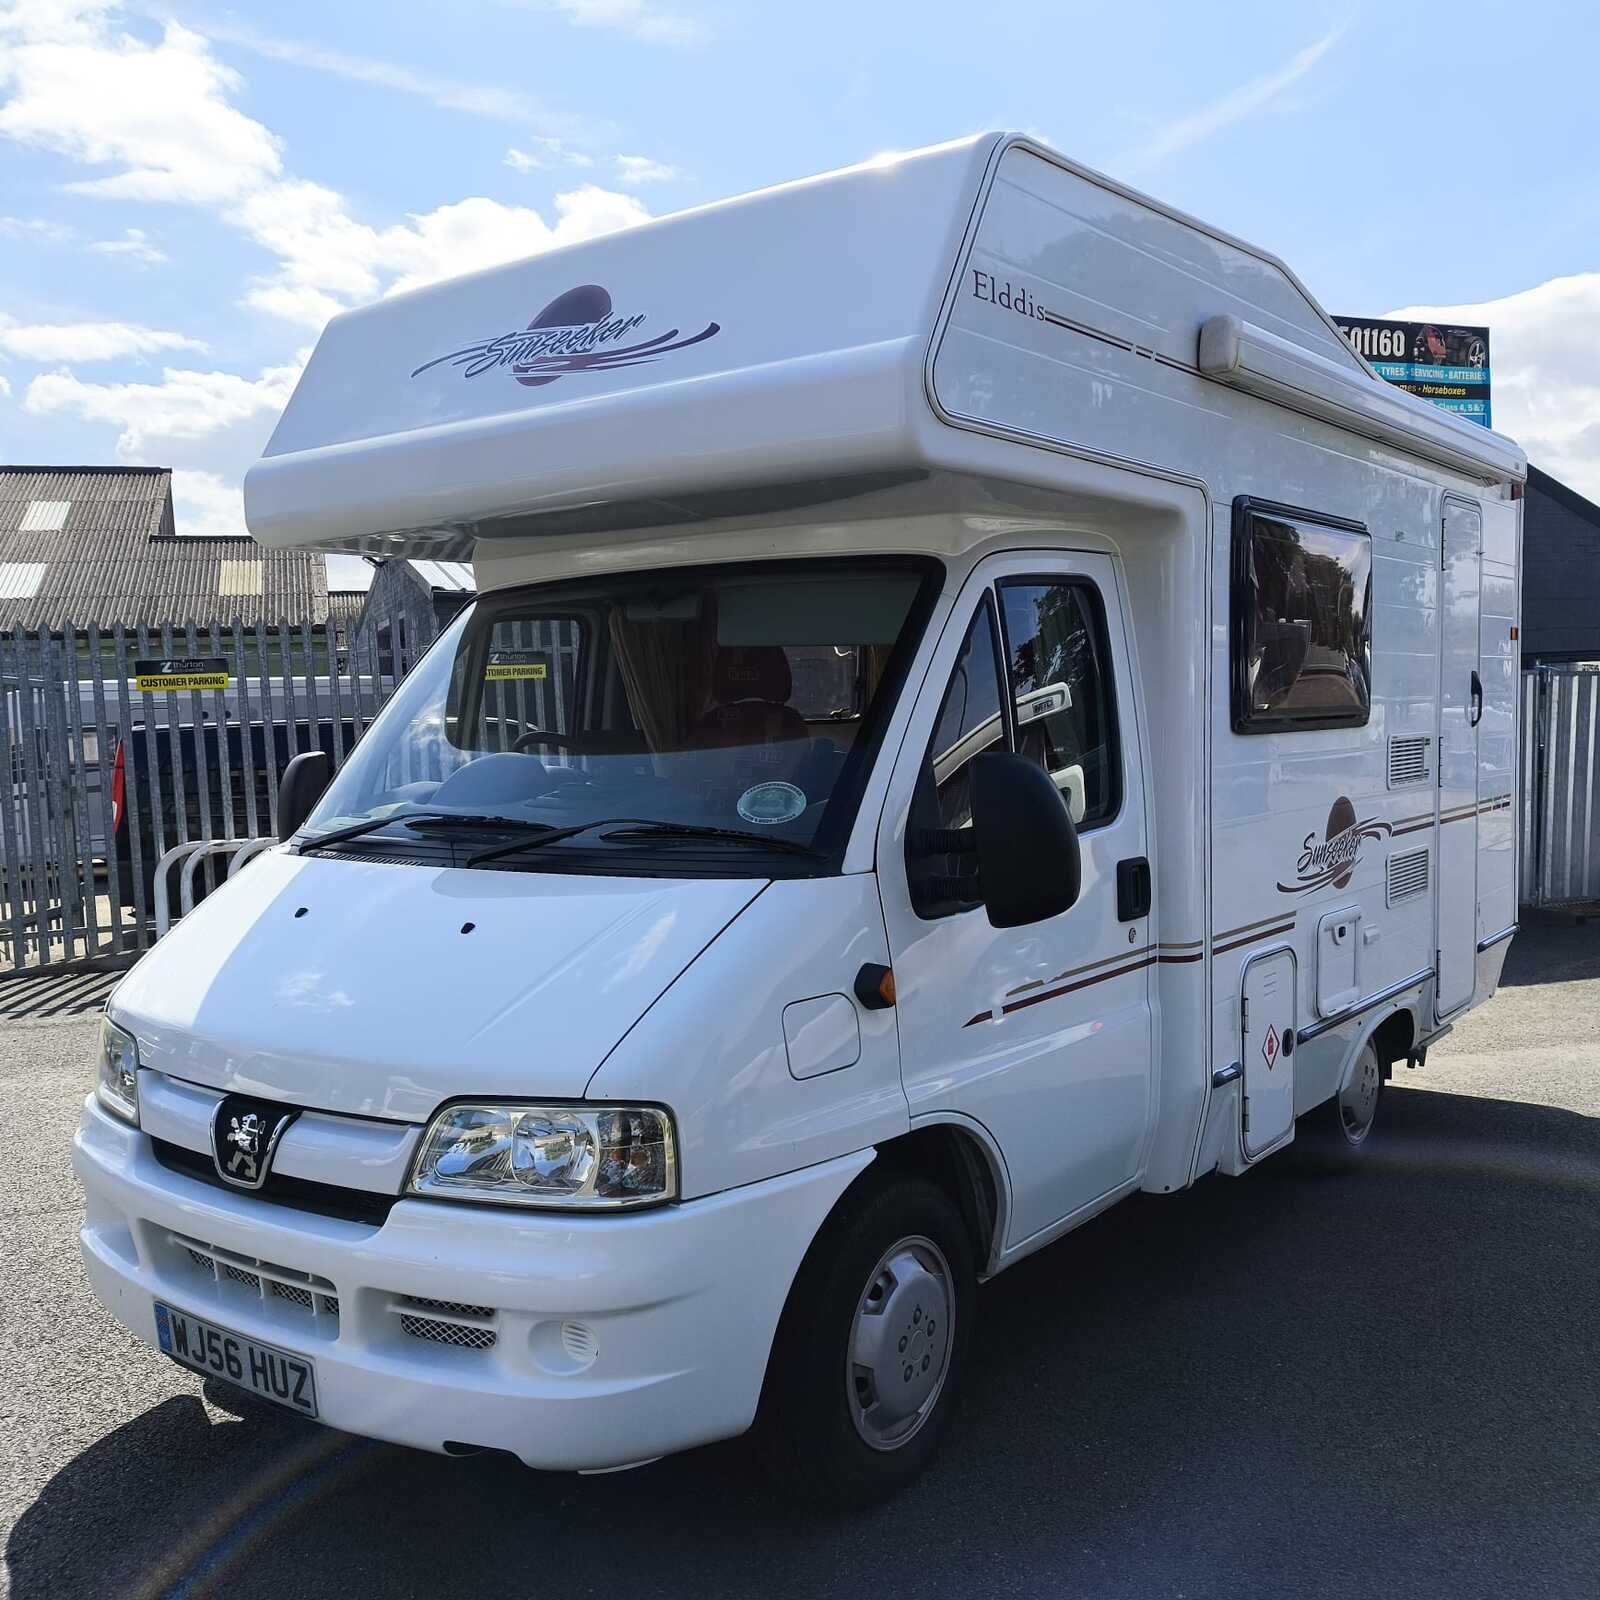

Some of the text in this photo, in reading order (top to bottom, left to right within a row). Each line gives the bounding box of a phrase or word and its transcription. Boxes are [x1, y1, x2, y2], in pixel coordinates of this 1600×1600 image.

[972, 269, 1046, 321] Elddis
[464, 312, 647, 378] Sunseeker
[1382, 366, 1405, 377] TYRES
[1411, 367, 1444, 379] SERVICING
[1448, 370, 1487, 380] BATTERIES
[1422, 384, 1466, 396] Horseboxes
[140, 676, 225, 688] CUSTOMER PARKING
[512, 667, 543, 676] PARKING
[1297, 828, 1361, 873] Sunseeker
[172, 1312, 311, 1408] WJ56 HUZ
